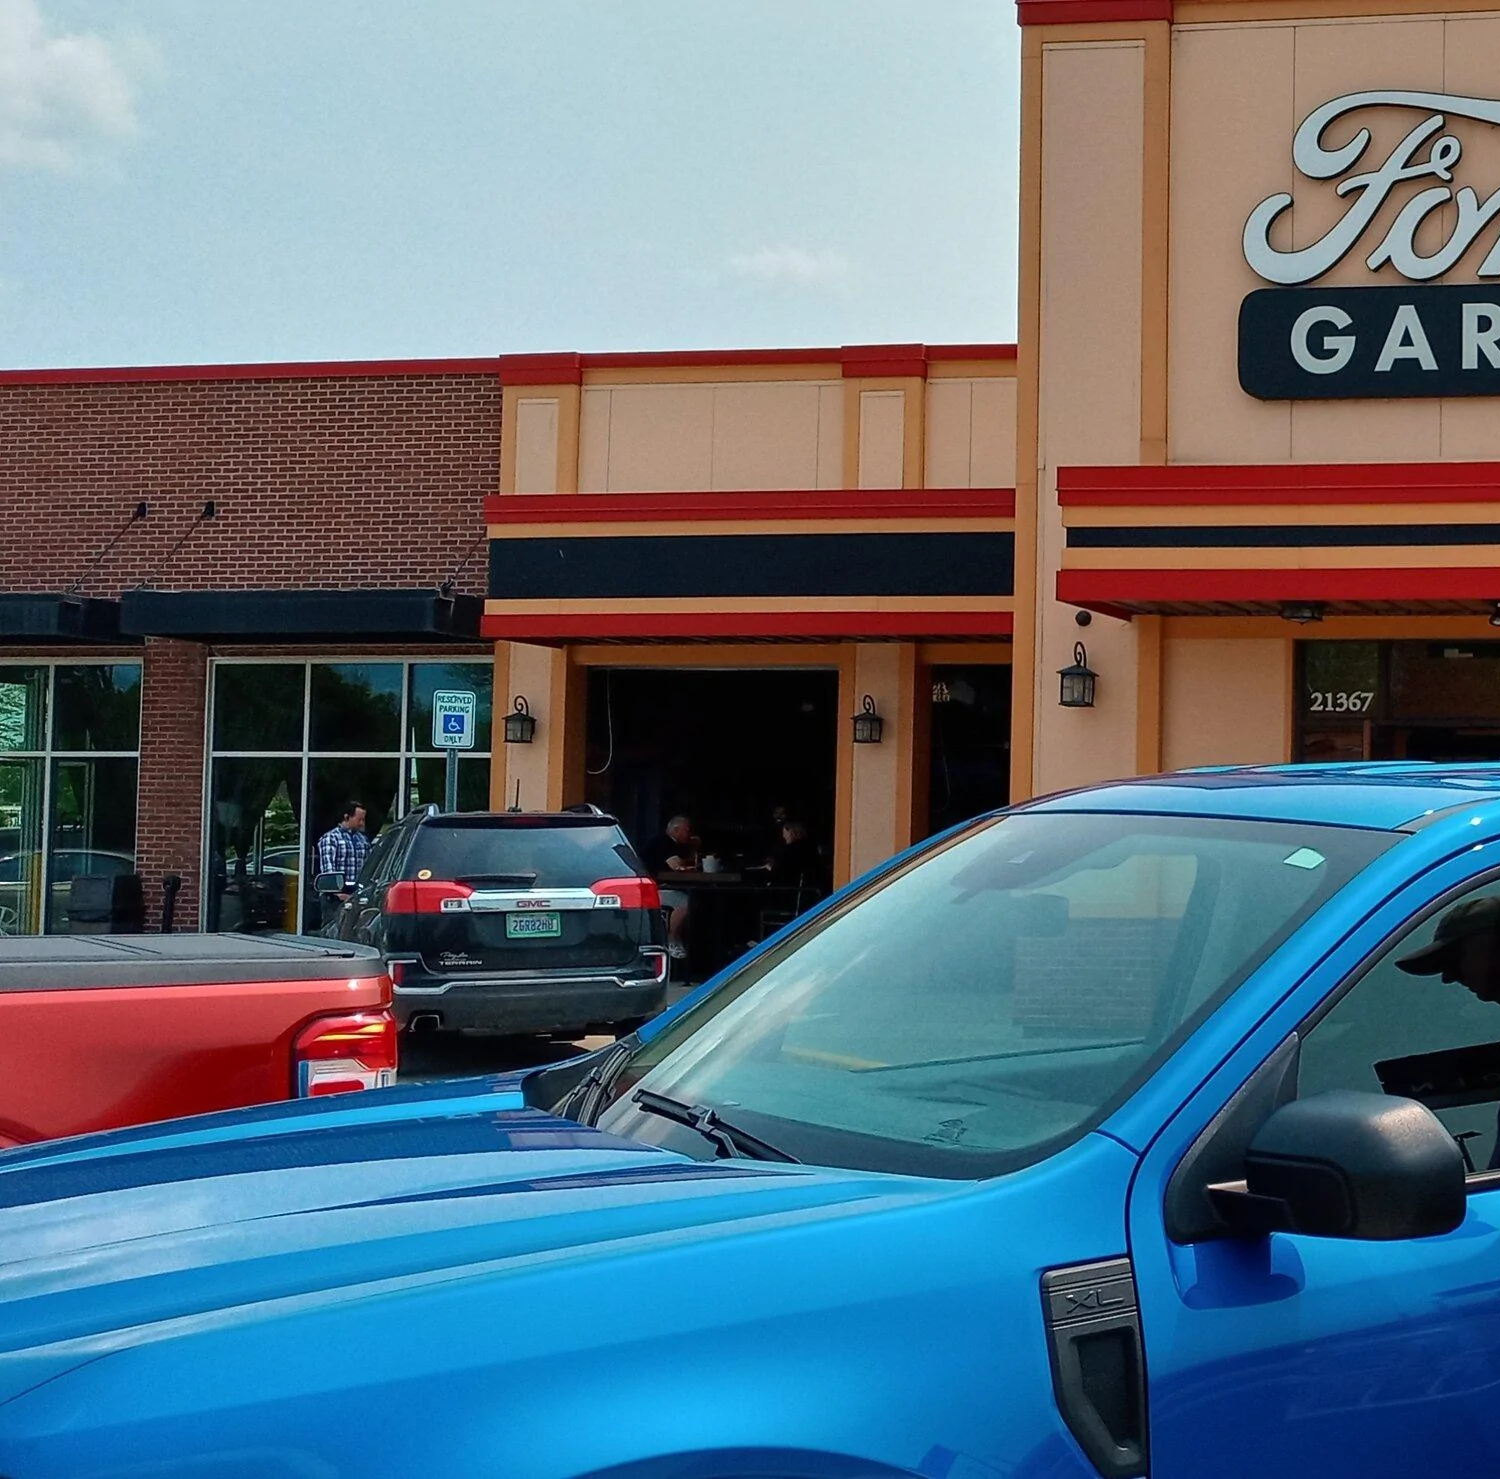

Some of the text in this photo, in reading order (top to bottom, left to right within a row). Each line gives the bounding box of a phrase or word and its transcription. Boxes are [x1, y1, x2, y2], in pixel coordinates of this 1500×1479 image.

[438, 695, 473, 705] RESERVED
[1310, 691, 1374, 712] 21367
[439, 705, 470, 714] PARKING
[444, 735, 463, 744] ONLY
[1065, 1289, 1124, 1314] XL
